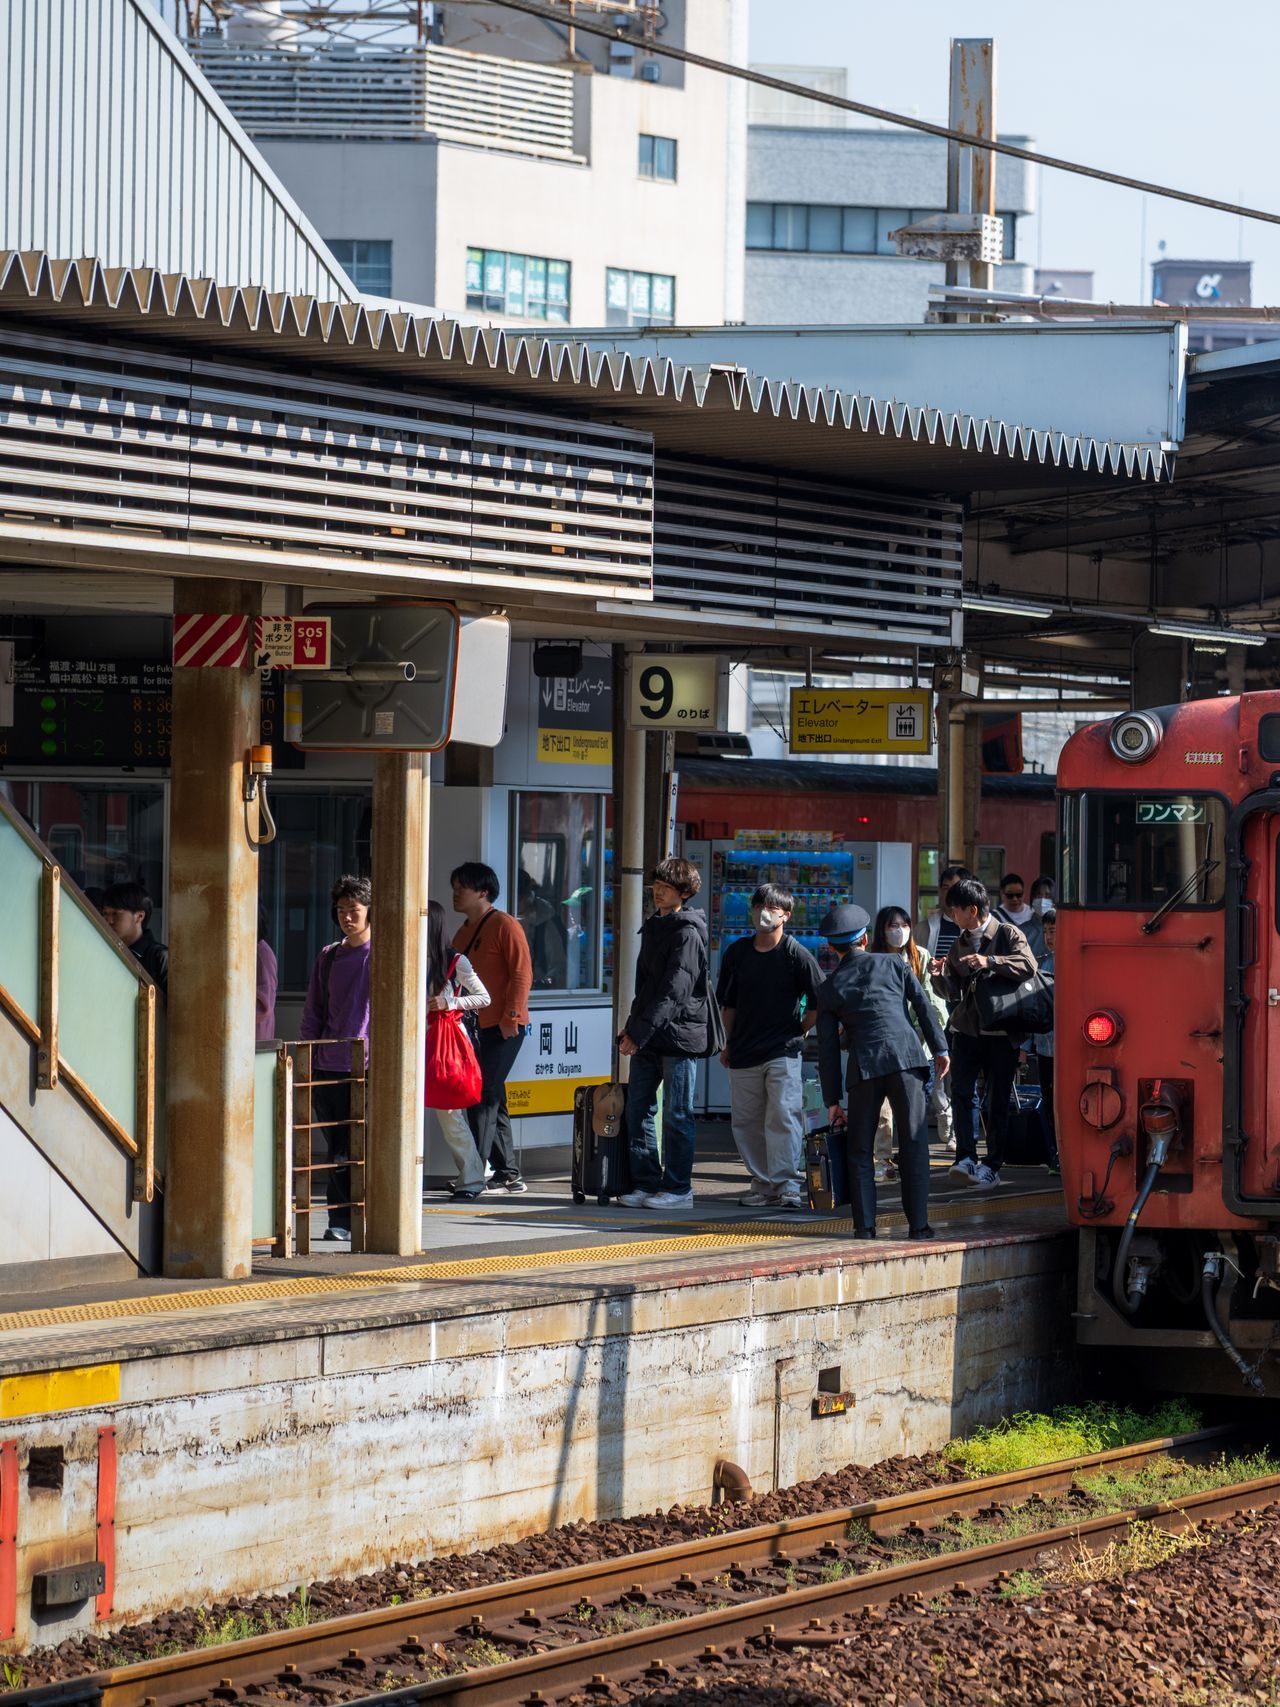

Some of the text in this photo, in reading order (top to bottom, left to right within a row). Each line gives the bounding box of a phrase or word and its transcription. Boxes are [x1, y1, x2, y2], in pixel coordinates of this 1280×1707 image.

[273, 623, 292, 633] 非常
[298, 627, 323, 638] SOS
[265, 634, 292, 643] ボタン
[143, 664, 155, 673] for
[143, 677, 155, 686] for
[567, 678, 612, 696] エレベーター
[640, 666, 673, 720] 9
[567, 699, 591, 713] Elevator
[797, 698, 884, 715] エレベーター
[677, 708, 710, 719] のりば
[798, 717, 838, 728] Elevator
[542, 734, 570, 752] 地下出口
[797, 733, 832, 743] 地下出口
[573, 736, 609, 753] Underground Exit
[1139, 804, 1204, 821] ワンマン
[540, 1021, 578, 1055] 岡山
[535, 1063, 554, 1075] おかやま
[558, 1063, 581, 1076] Okayama
